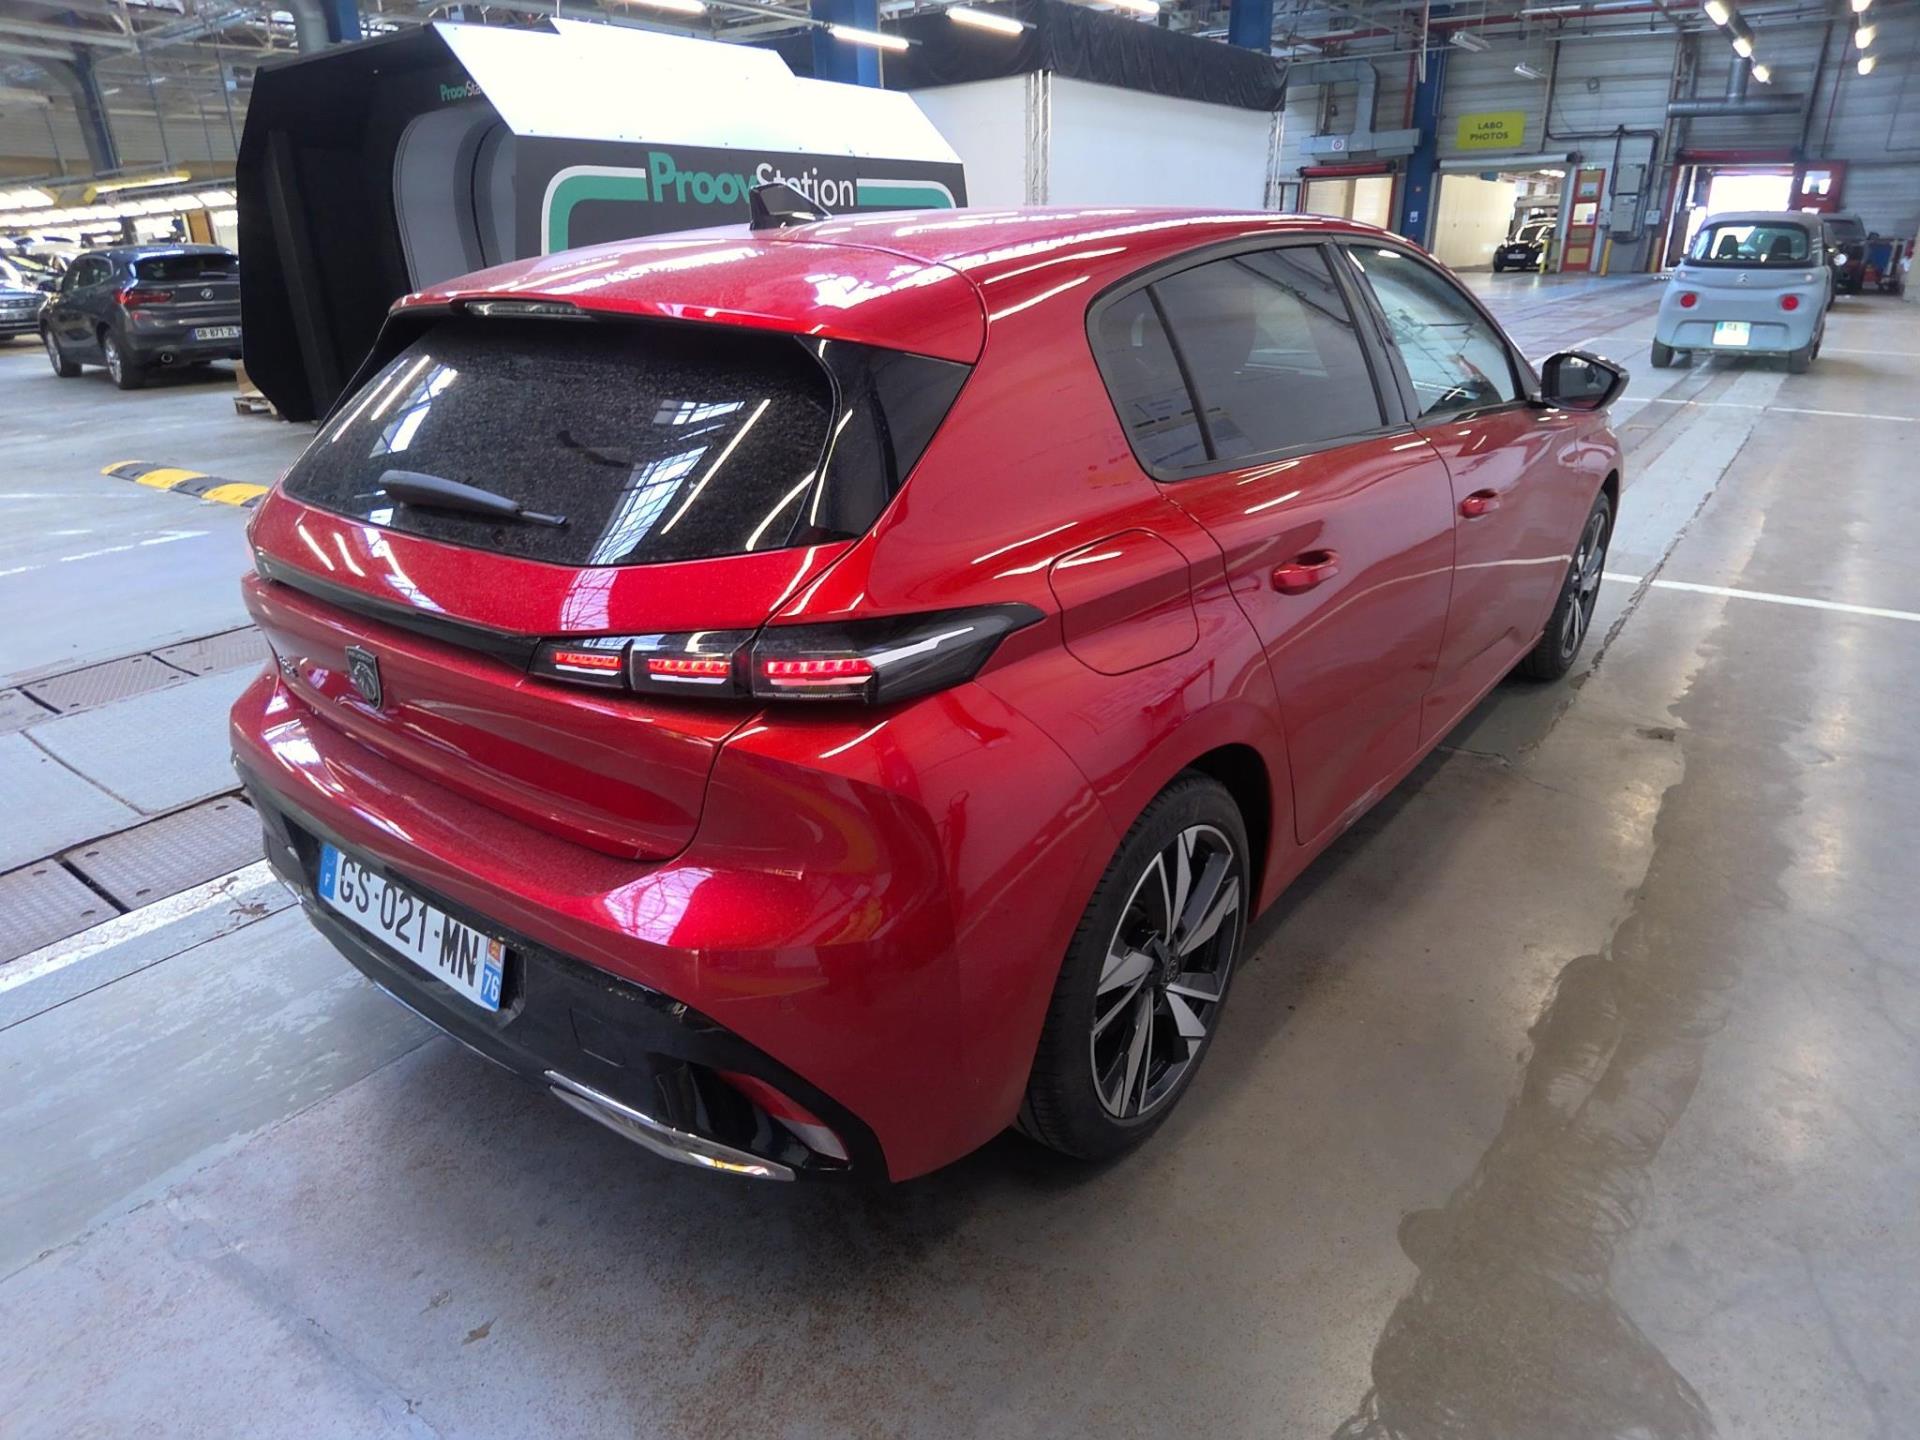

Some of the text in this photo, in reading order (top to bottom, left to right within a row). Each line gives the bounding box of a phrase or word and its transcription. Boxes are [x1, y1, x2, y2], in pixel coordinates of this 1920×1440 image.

[1470, 131, 1508, 141] PHOTOS
[1477, 121, 1503, 130] LABO
[648, 151, 855, 207] ProovStion
[324, 873, 332, 886] F
[339, 856, 480, 988] GS-021-MN
[482, 968, 501, 1002] 76
